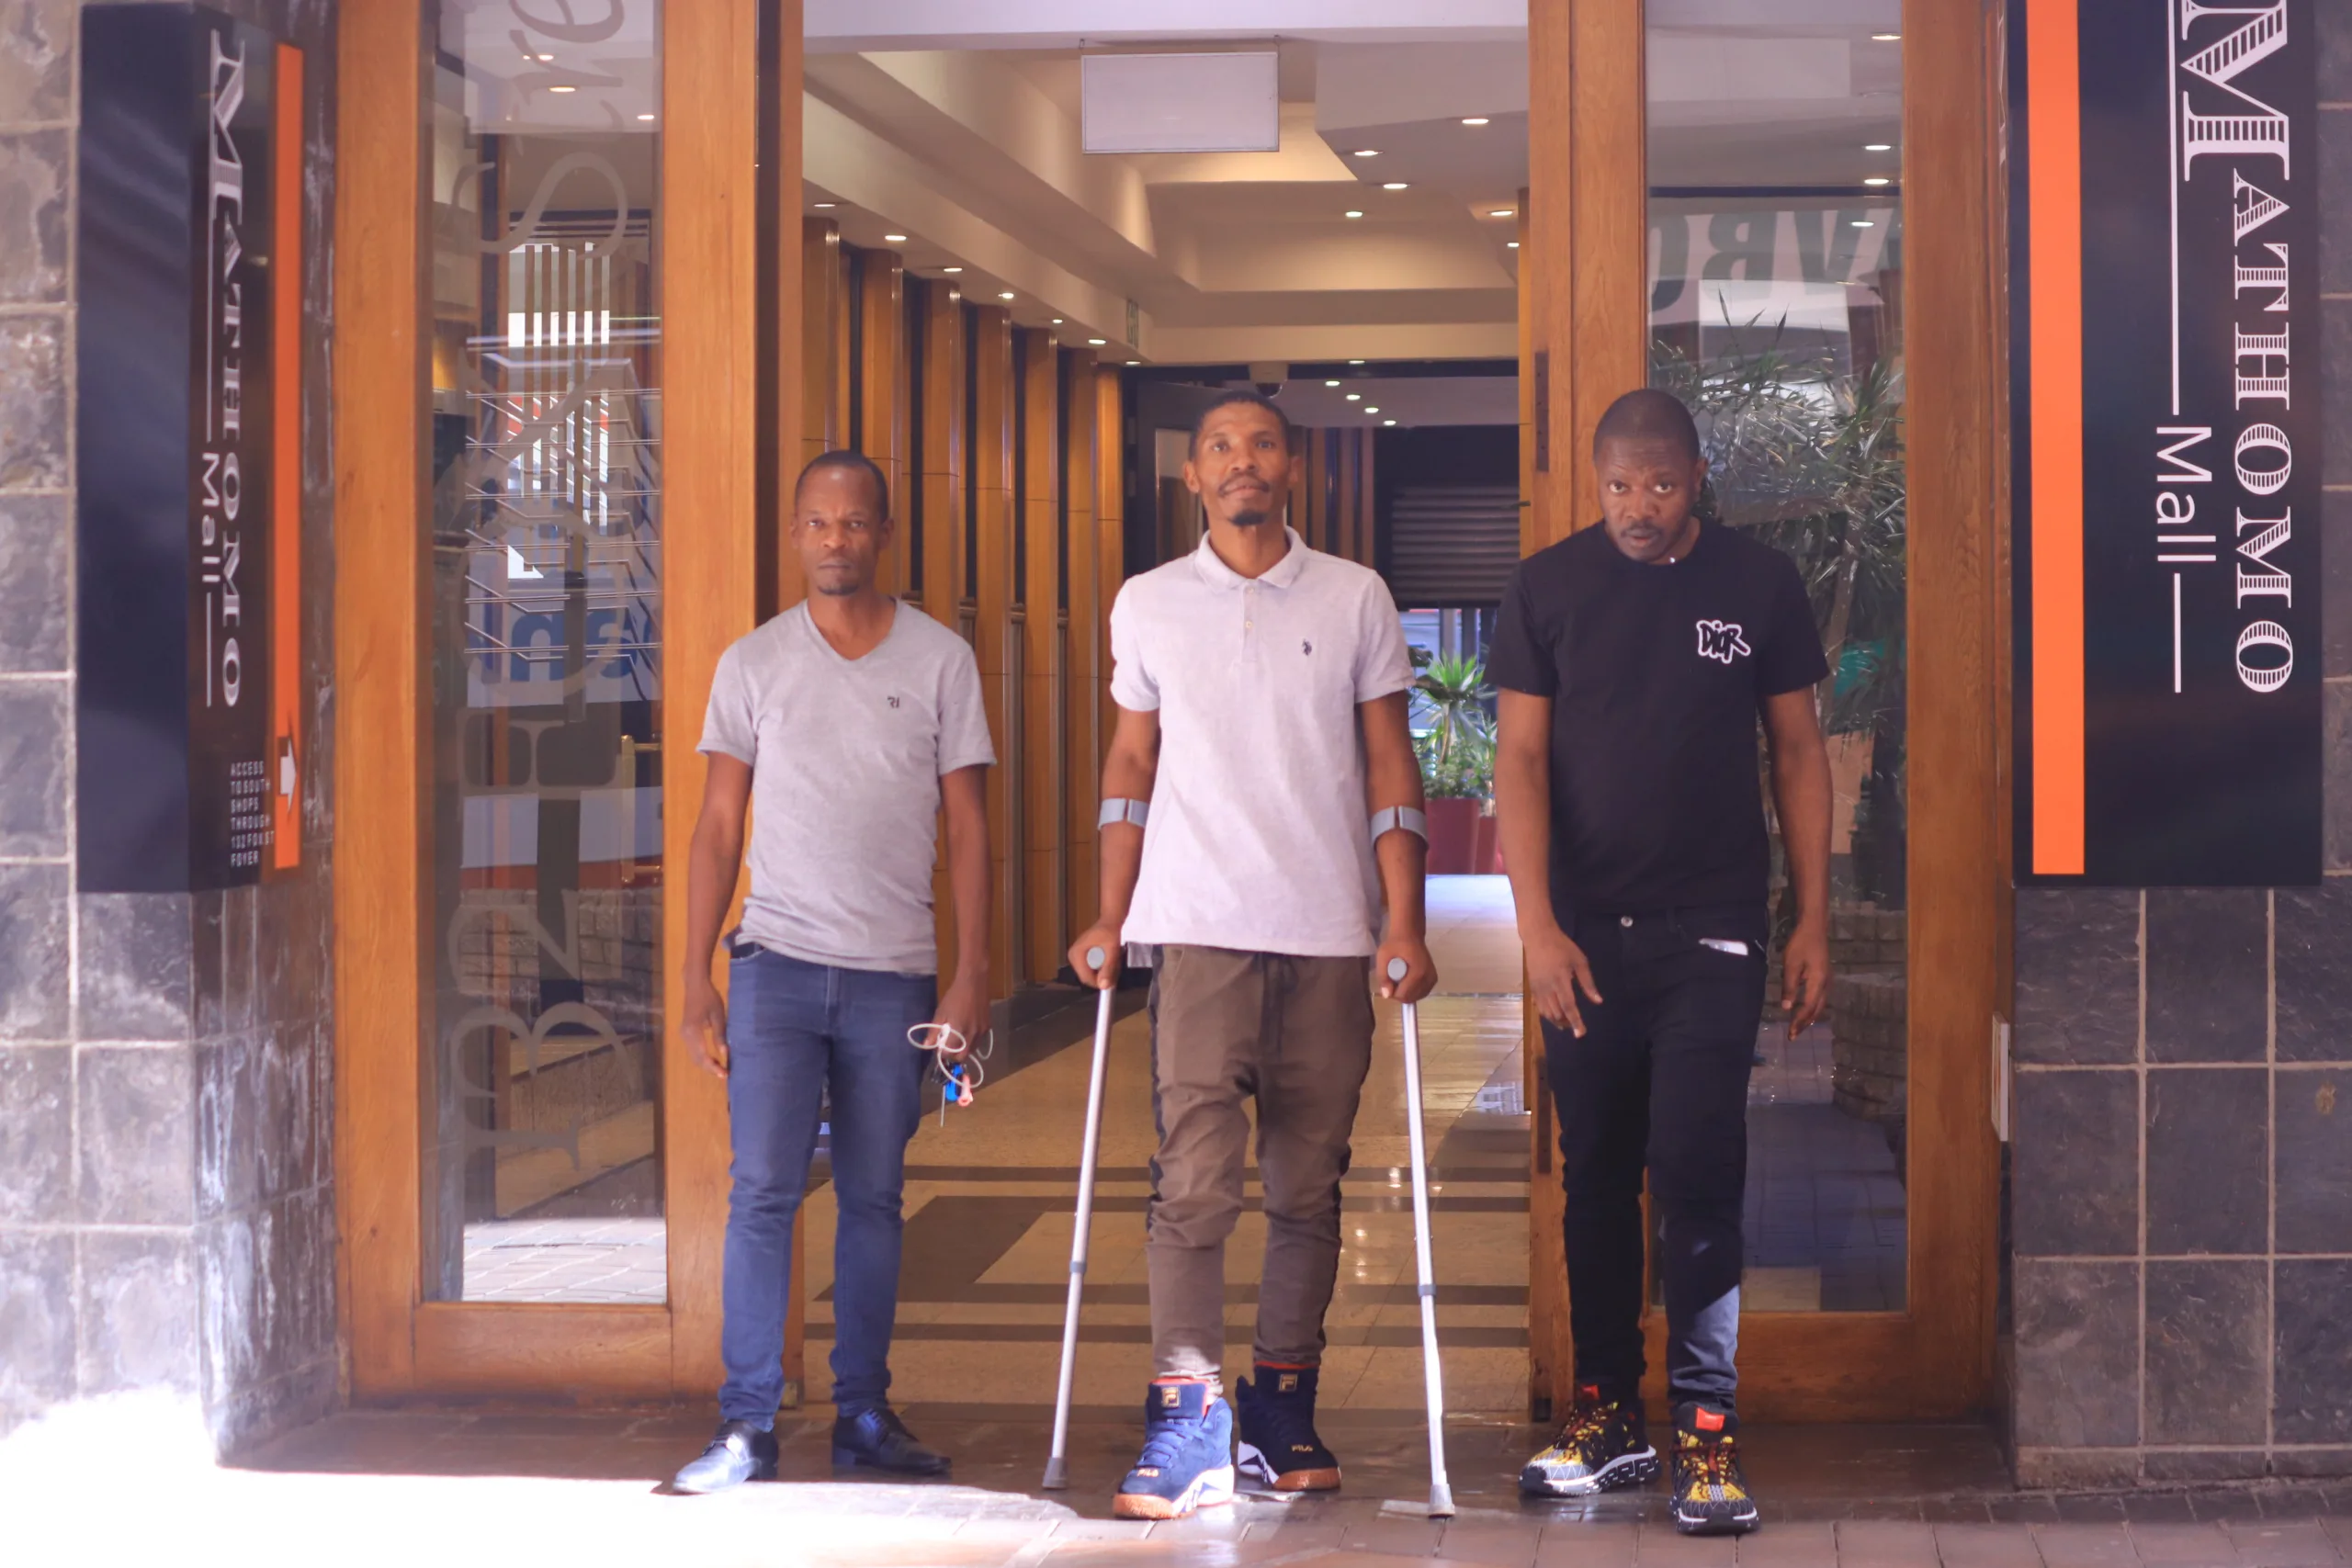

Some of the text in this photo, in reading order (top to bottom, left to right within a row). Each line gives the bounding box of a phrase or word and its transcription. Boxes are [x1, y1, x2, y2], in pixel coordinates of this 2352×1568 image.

[212, 29, 245, 706] MATHOMO
[2181, 0, 2293, 693] MATHOMO
[202, 453, 220, 582] Mall
[2156, 426, 2216, 561] Mall
[230, 760, 264, 777] ACCESS
[230, 796, 259, 814] SHOPS
[230, 849, 259, 868] FOYER
[1291, 1444, 1314, 1452] FILA
